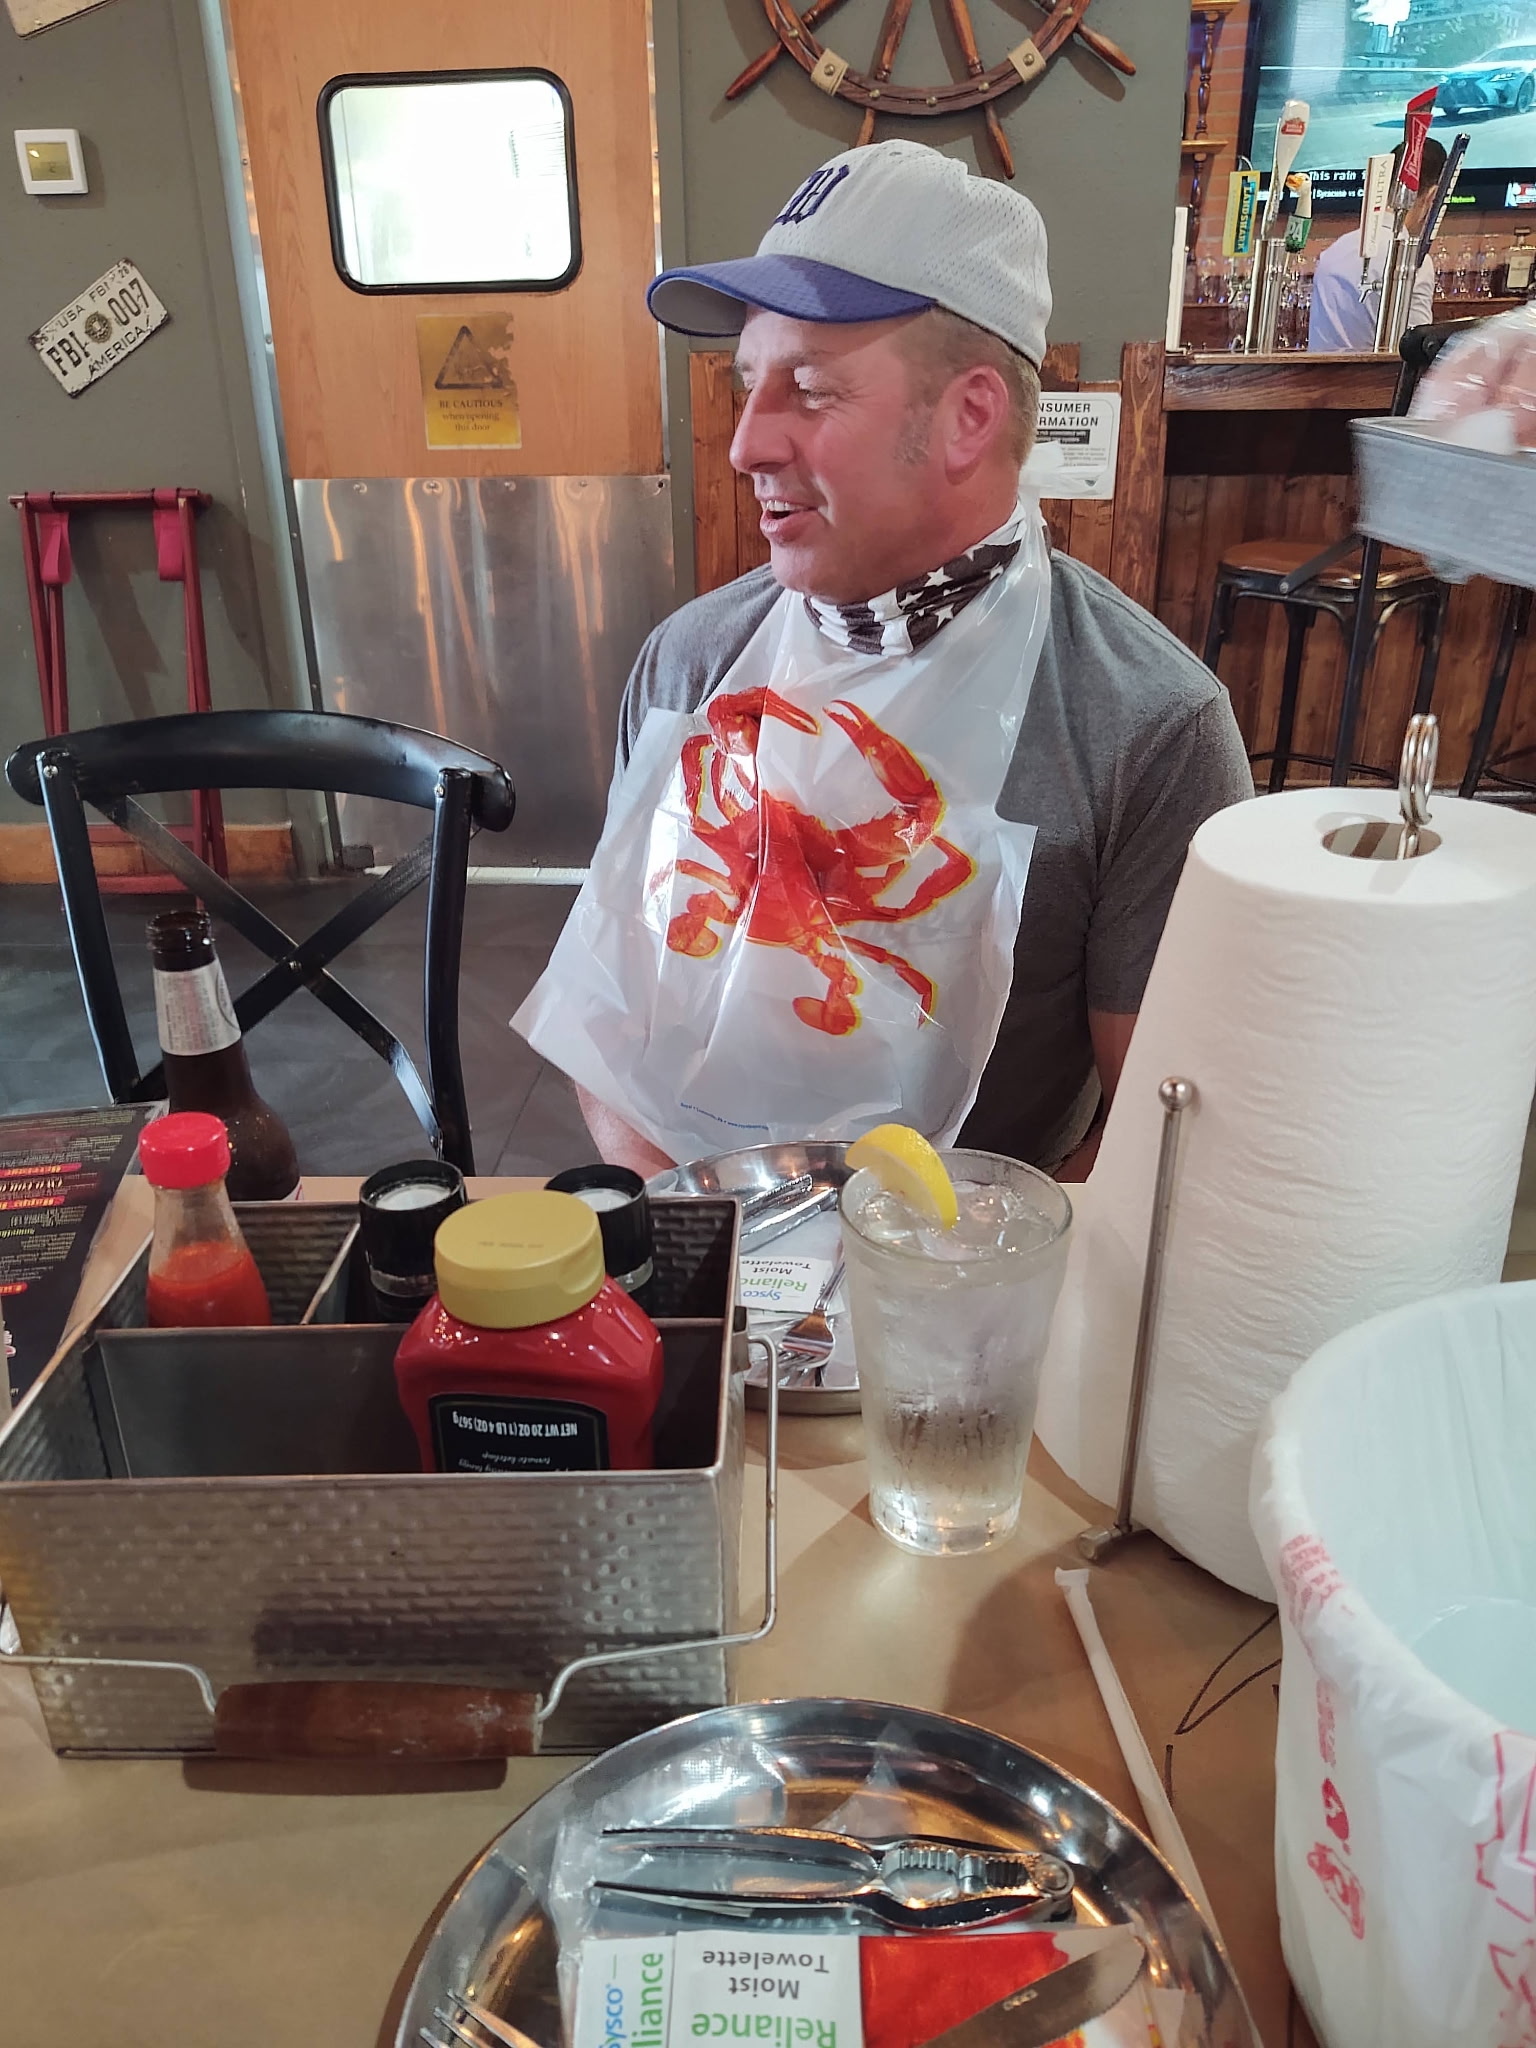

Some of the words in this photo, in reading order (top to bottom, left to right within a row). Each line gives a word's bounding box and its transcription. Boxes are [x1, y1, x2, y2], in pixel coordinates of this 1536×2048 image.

[1375, 160, 1388, 205] ULTRA
[1237, 186, 1252, 252] LANDSHARK
[58, 305, 86, 329] USA
[89, 281, 110, 303] FBI
[46, 331, 90, 377] FBI
[107, 277, 150, 326] 007
[88, 326, 146, 376] AMERICA
[1038, 402, 1091, 413] NSUMER
[1039, 416, 1099, 427] RMATION
[741, 1260, 811, 1270] Towelette
[752, 1267, 793, 1275] Moist
[743, 1289, 782, 1301] Sysco
[452, 1411, 473, 1430] 567g
[474, 1416, 488, 1433] OZ)
[489, 1421, 496, 1433] 4
[496, 1422, 508, 1435] LB
[508, 1422, 518, 1436] (1
[518, 1424, 531, 1437] OZ
[531, 1424, 543, 1437] 20
[545, 1424, 560, 1437] WT
[560, 1423, 578, 1437] NET
[482, 1450, 516, 1465] ketchup
[702, 1950, 830, 1974] Towelette
[728, 1977, 800, 2000] Moist
[632, 1952, 663, 2048] liance
[690, 2012, 837, 2048] Reliance
